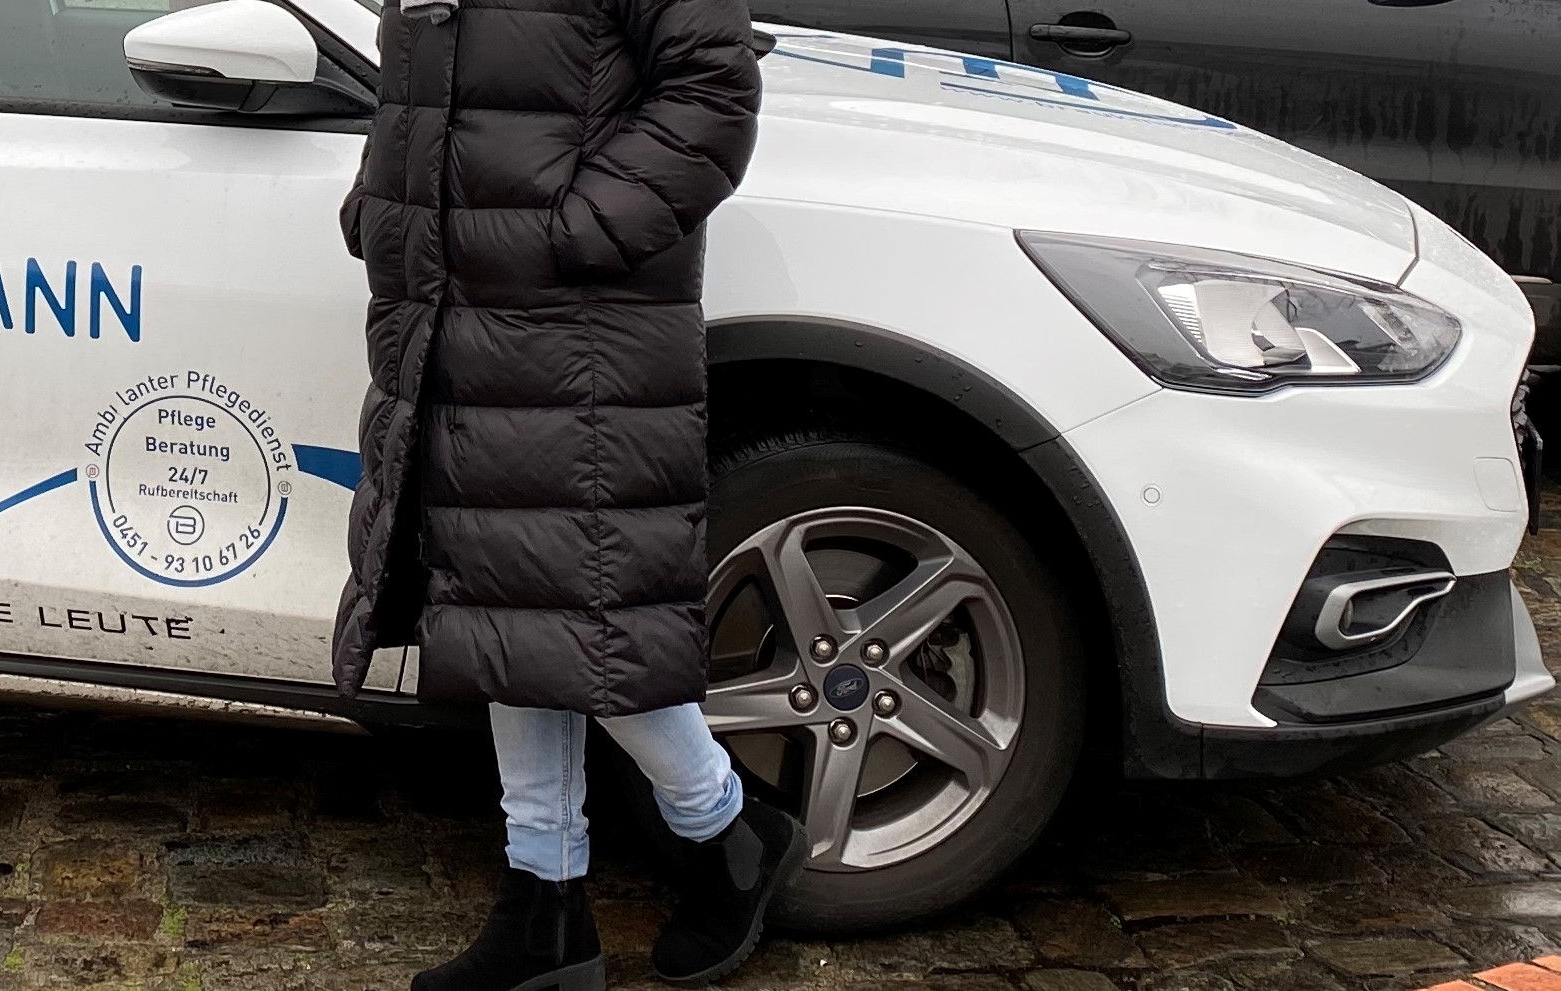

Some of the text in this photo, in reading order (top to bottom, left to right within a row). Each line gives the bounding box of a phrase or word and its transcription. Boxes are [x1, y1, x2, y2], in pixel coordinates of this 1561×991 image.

[158, 409, 216, 431] Pflege
[187, 370, 292, 472] Pflegedienst
[145, 436, 230, 461] Beratung
[168, 467, 208, 485] 24/7
[138, 484, 238, 504] Rufbereitschaft
[113, 514, 149, 556] 0451
[164, 554, 185, 573] 93
[192, 555, 213, 573] 10
[219, 542, 239, 566] 67
[239, 525, 261, 550] 26
[38, 605, 193, 641] LEUTE
